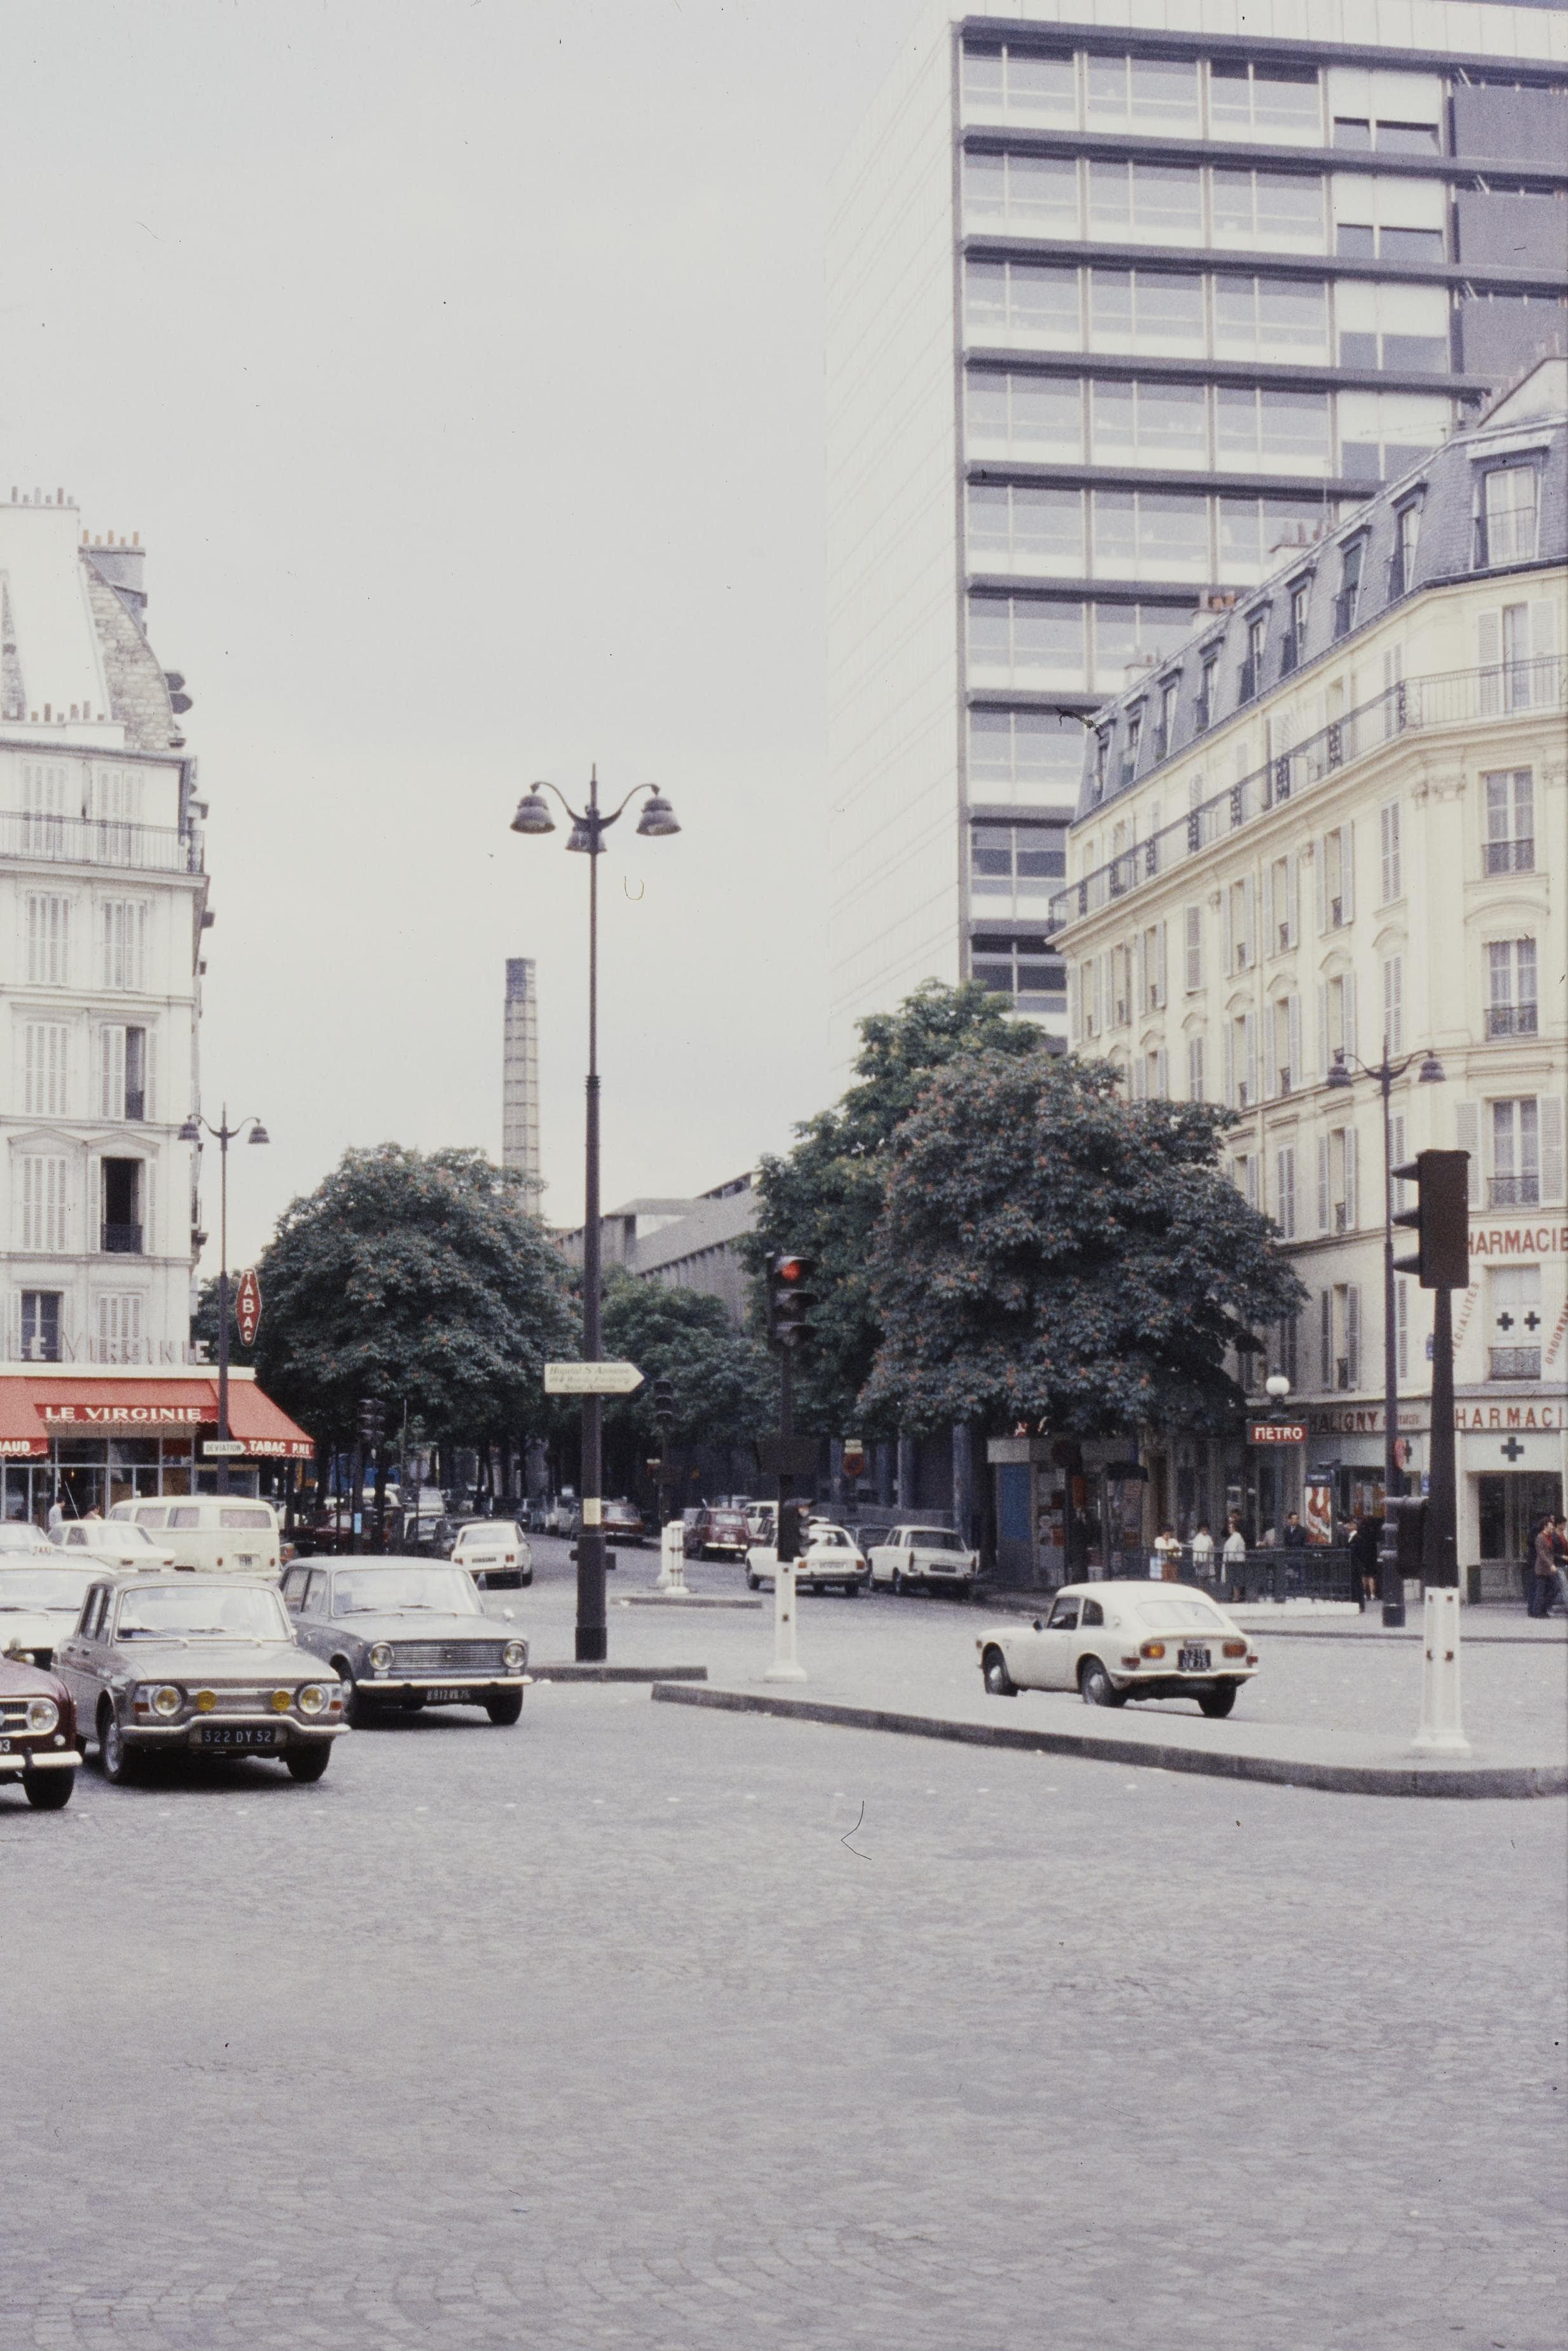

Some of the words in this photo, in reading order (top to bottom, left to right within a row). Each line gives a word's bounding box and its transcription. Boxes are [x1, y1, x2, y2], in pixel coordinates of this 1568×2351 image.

[1468, 1227, 1568, 1256] HARMACIE
[243, 1271, 254, 1341] TABAC
[1453, 1281, 1480, 1357] ECIALITES
[45, 1406, 74, 1420] LE
[84, 1407, 201, 1421] VIRGINIE
[1454, 1407, 1562, 1428] HARMACI
[1255, 1426, 1303, 1440] METRO
[0, 1440, 30, 1453] AUD
[249, 1440, 286, 1453] TABAC
[205, 1730, 231, 1742] 322
[236, 1730, 252, 1742] DY
[257, 1730, 271, 1742] 52
